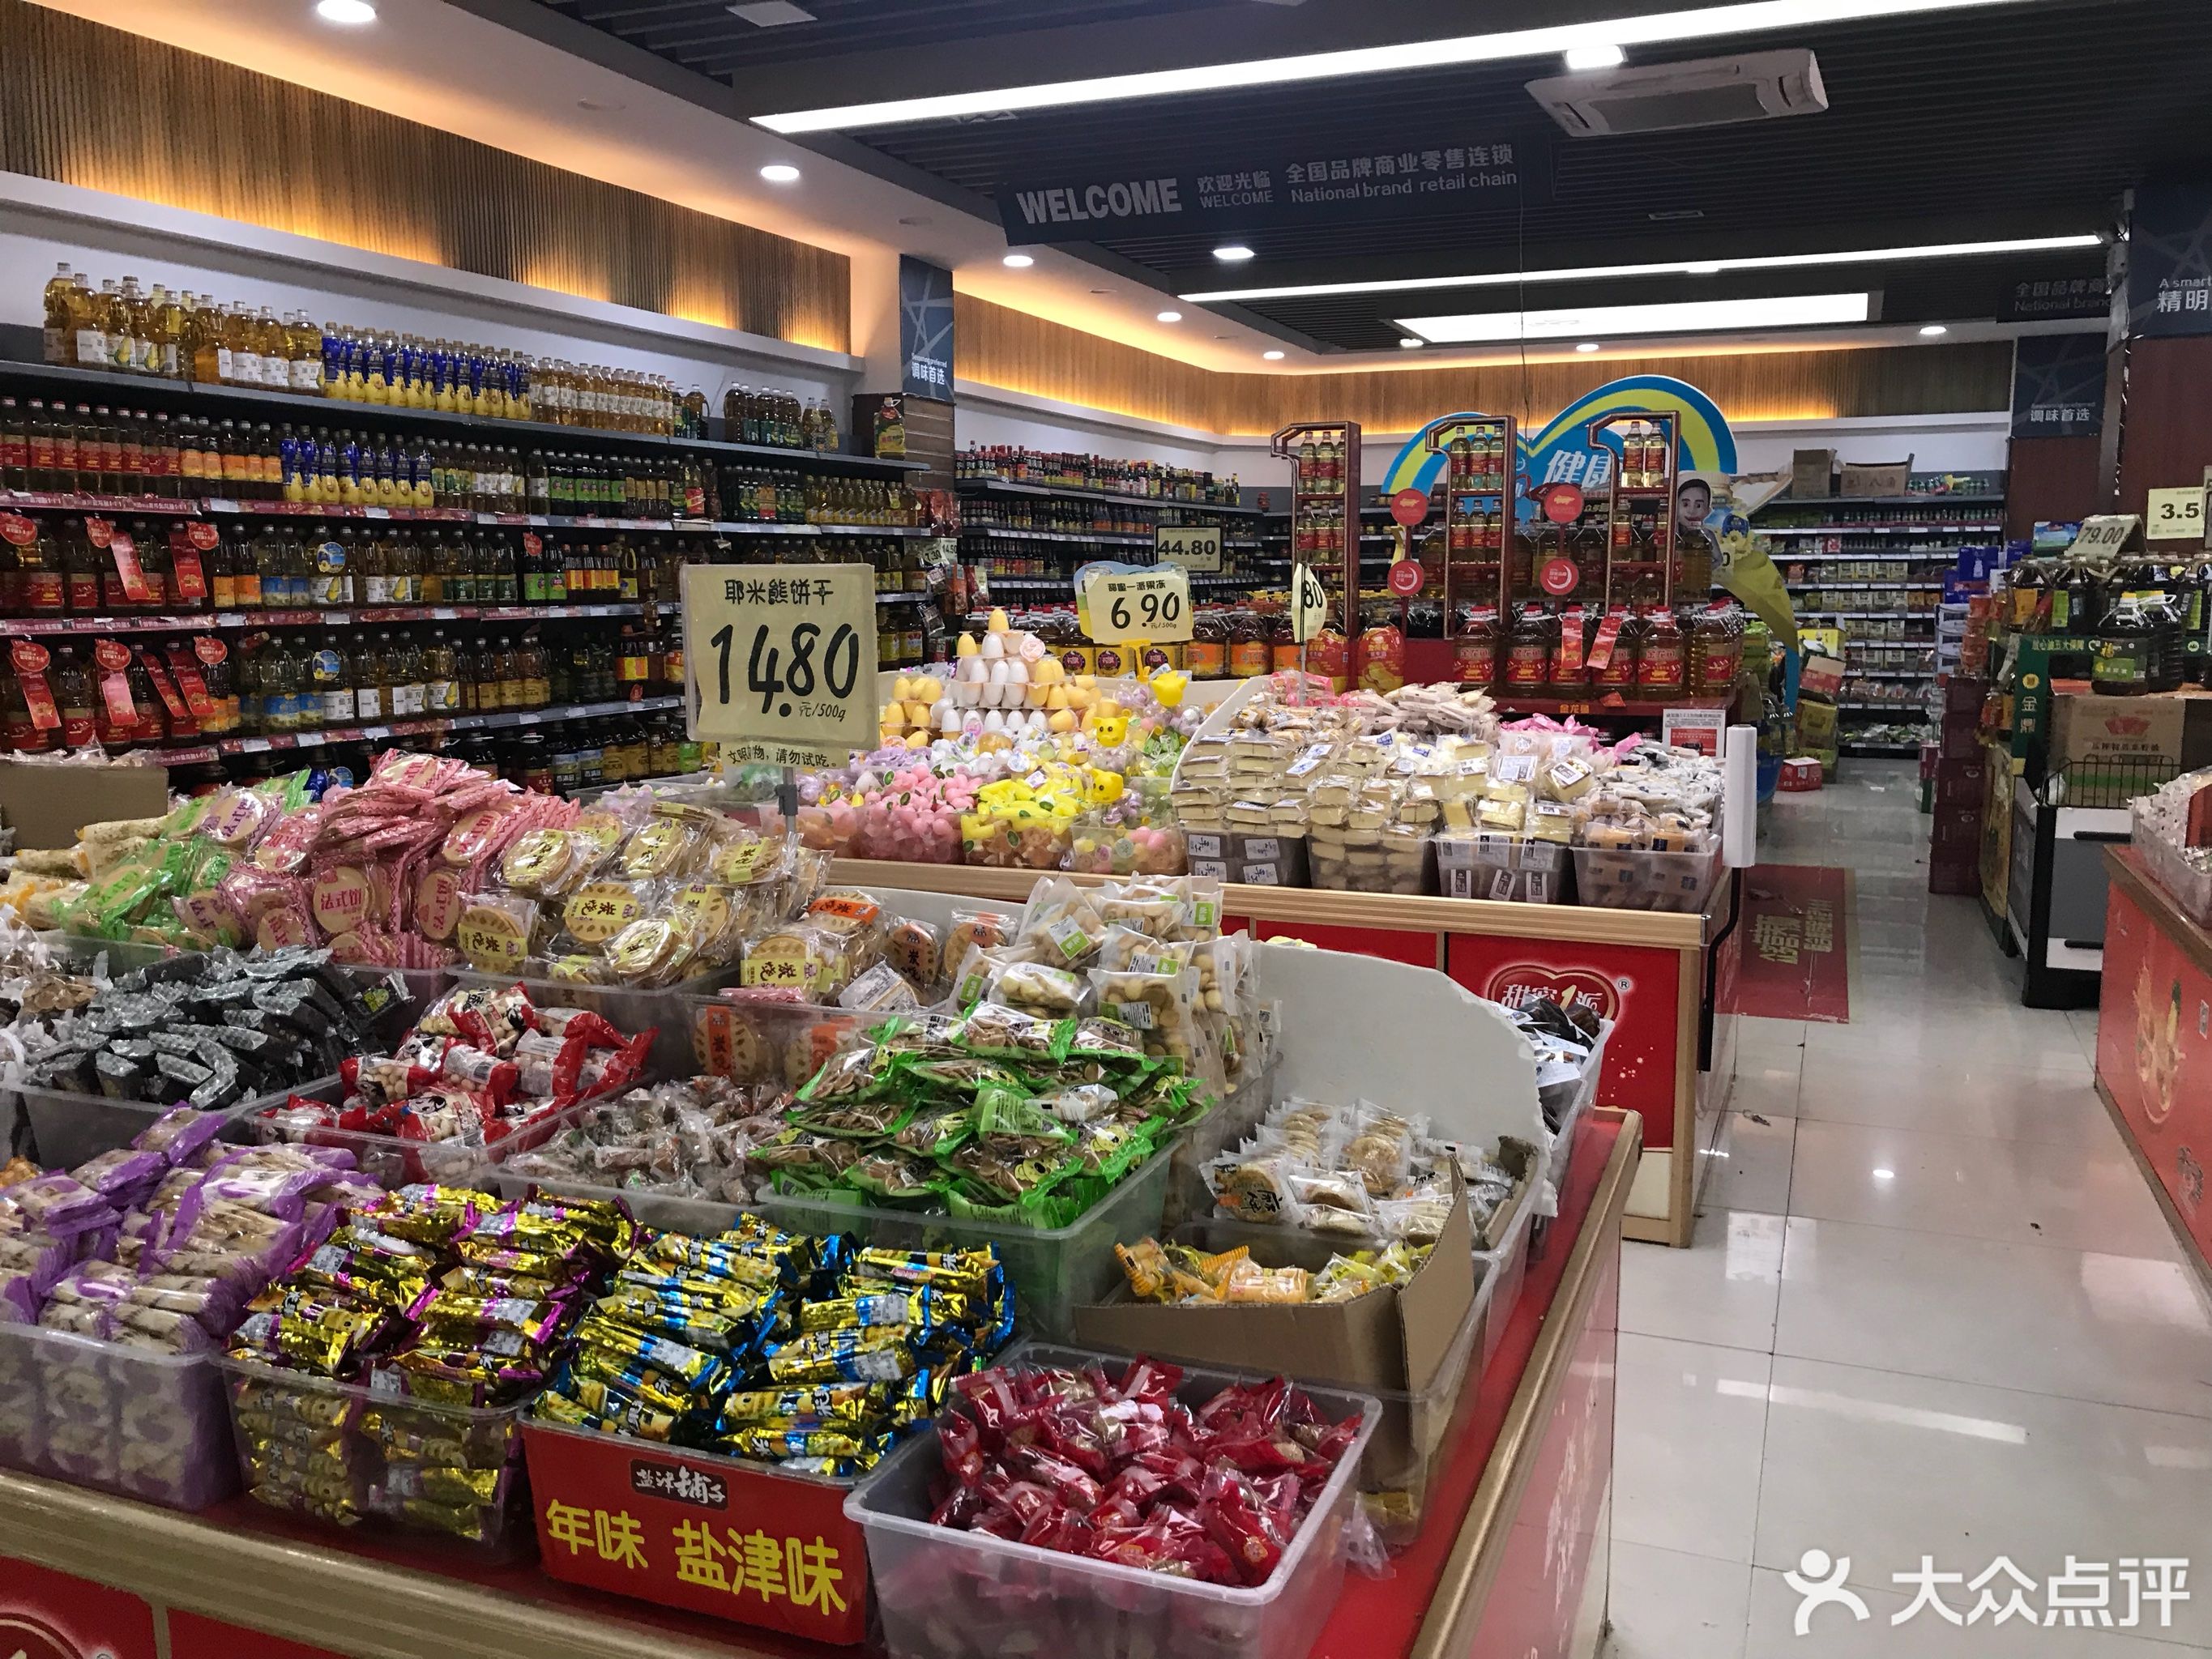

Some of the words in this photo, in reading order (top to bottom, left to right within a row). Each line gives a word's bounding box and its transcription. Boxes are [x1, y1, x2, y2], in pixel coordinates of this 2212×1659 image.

[1285, 143, 1514, 185] 全国品牌商业零售连锁
[1198, 169, 1270, 194] 欢迎光临
[1292, 181, 1359, 203] National
[1362, 177, 1412, 199] brand
[1420, 173, 1465, 192] retail
[1469, 169, 1517, 188] chain
[1017, 178, 1182, 225] WELCOME
[1199, 190, 1274, 209] WELCOME
[2159, 278, 2169, 288] A
[2172, 275, 2212, 288] smart
[2157, 289, 2209, 313] 精明
[912, 361, 945, 386] 调味首选
[2031, 407, 2090, 422] 调味首选
[2160, 501, 2200, 519] 3.5
[1158, 539, 1216, 556] 44.80
[2081, 527, 2124, 544] 79.00
[724, 578, 834, 605] 耶米熊饼干
[1111, 591, 1180, 629] 6.90
[710, 622, 860, 718] 14.80
[799, 702, 846, 722] 元/500g
[728, 745, 838, 768] 文明物，请勿试吃。
[634, 1465, 726, 1504] 盐津铺子
[545, 1499, 649, 1570] 年味
[673, 1519, 848, 1616] 盐津味
